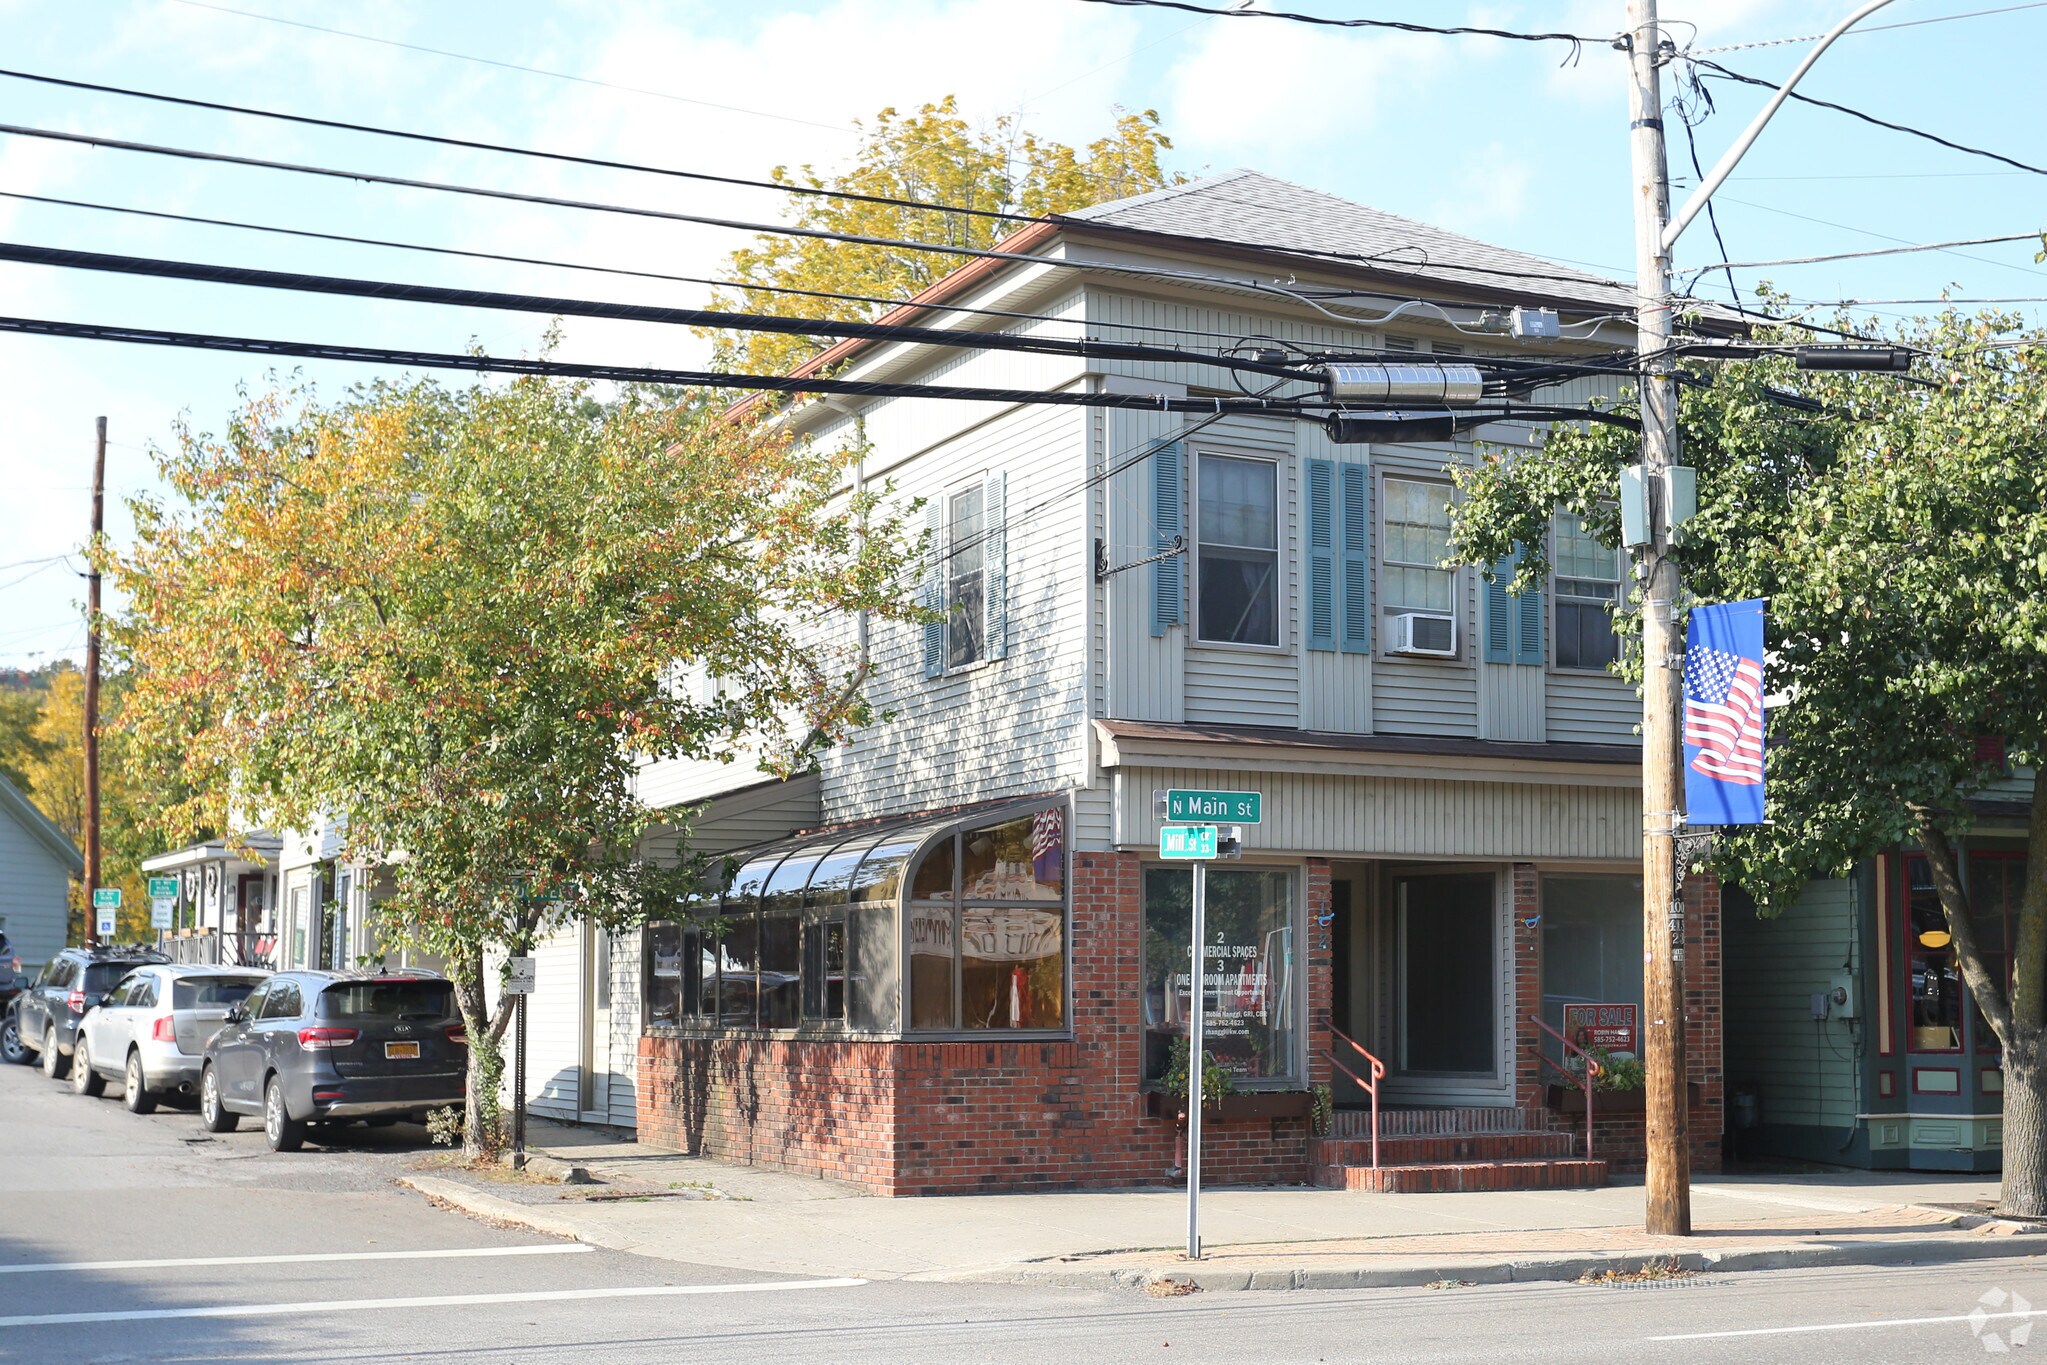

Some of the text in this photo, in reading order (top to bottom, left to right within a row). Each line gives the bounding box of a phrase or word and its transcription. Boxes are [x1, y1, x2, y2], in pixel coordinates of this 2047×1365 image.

[1173, 797, 1252, 816] N Main St
[1188, 838, 1197, 851] St
[1217, 931, 1225, 944] 2
[1232, 945, 1257, 958] SPACES
[1217, 959, 1225, 972] 3
[1176, 973, 1268, 986] ONE ROOM APARTMENTS
[1569, 1007, 1632, 1026] FOR SALE
